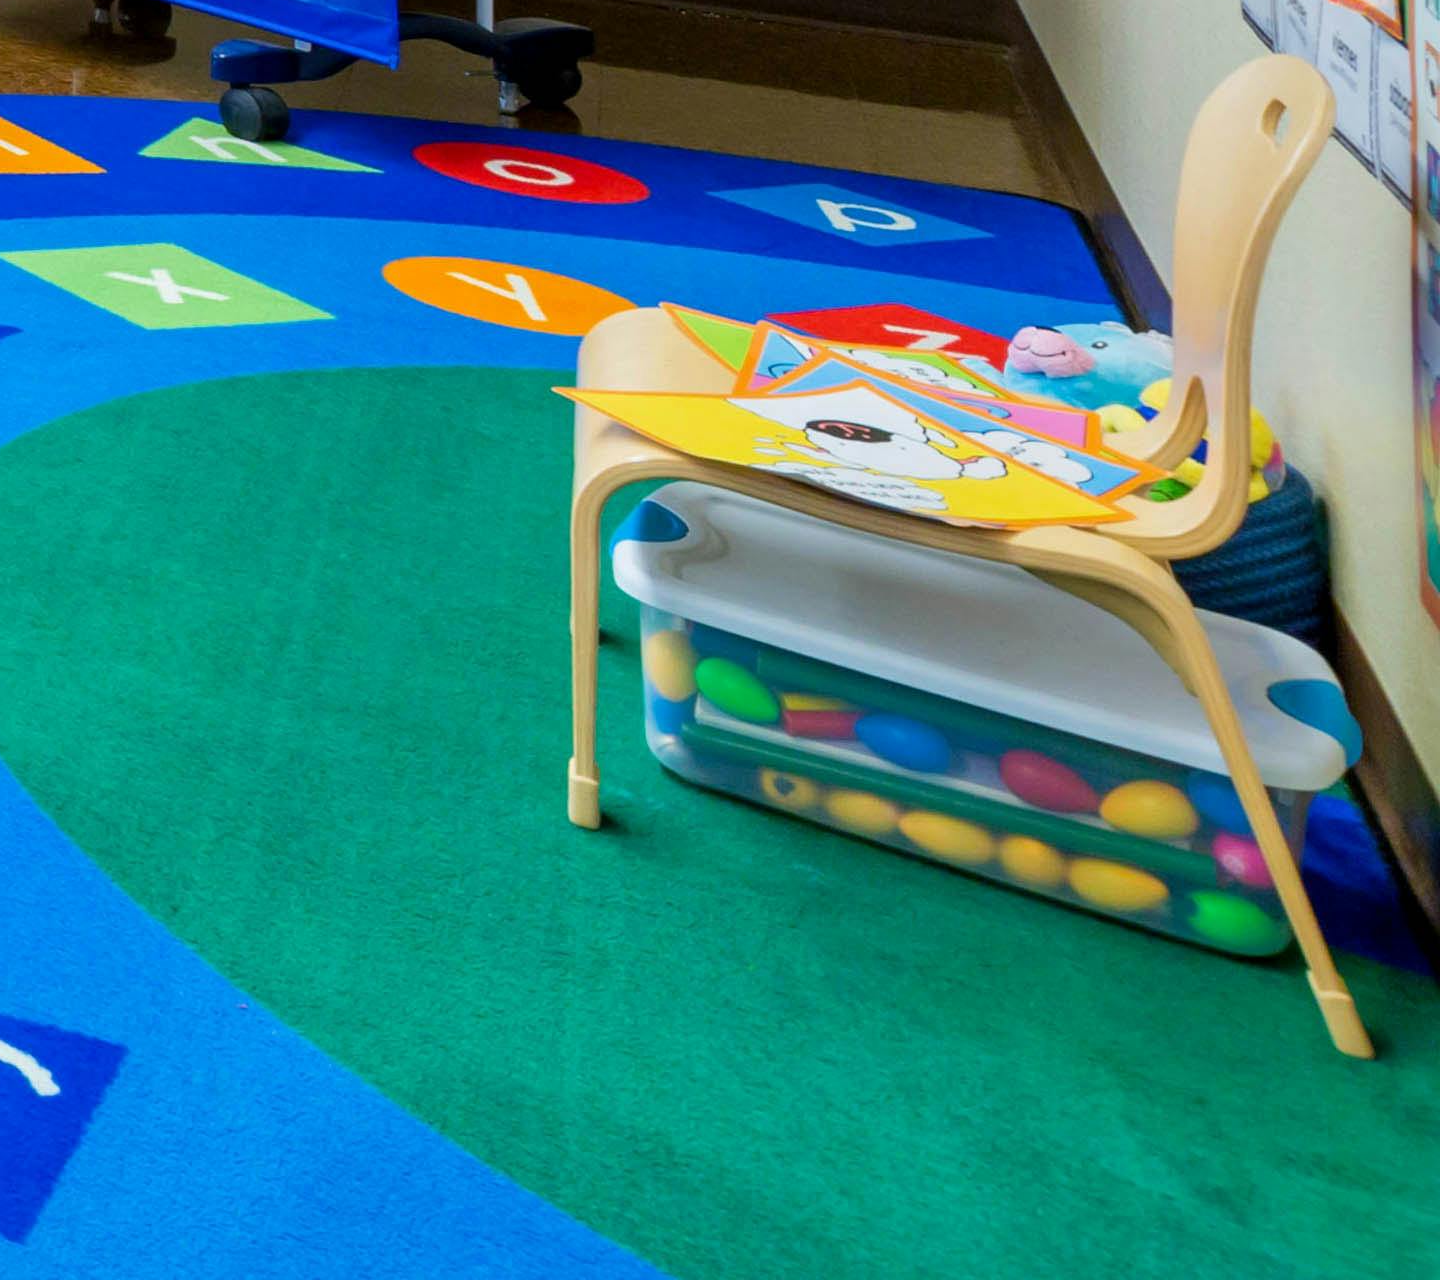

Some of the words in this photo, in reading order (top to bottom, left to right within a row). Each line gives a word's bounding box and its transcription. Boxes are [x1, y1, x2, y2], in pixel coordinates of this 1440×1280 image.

[190, 134, 288, 163] n
[484, 160, 574, 186] o
[817, 200, 916, 232] p
[101, 266, 232, 306] x
[452, 273, 546, 321] y
